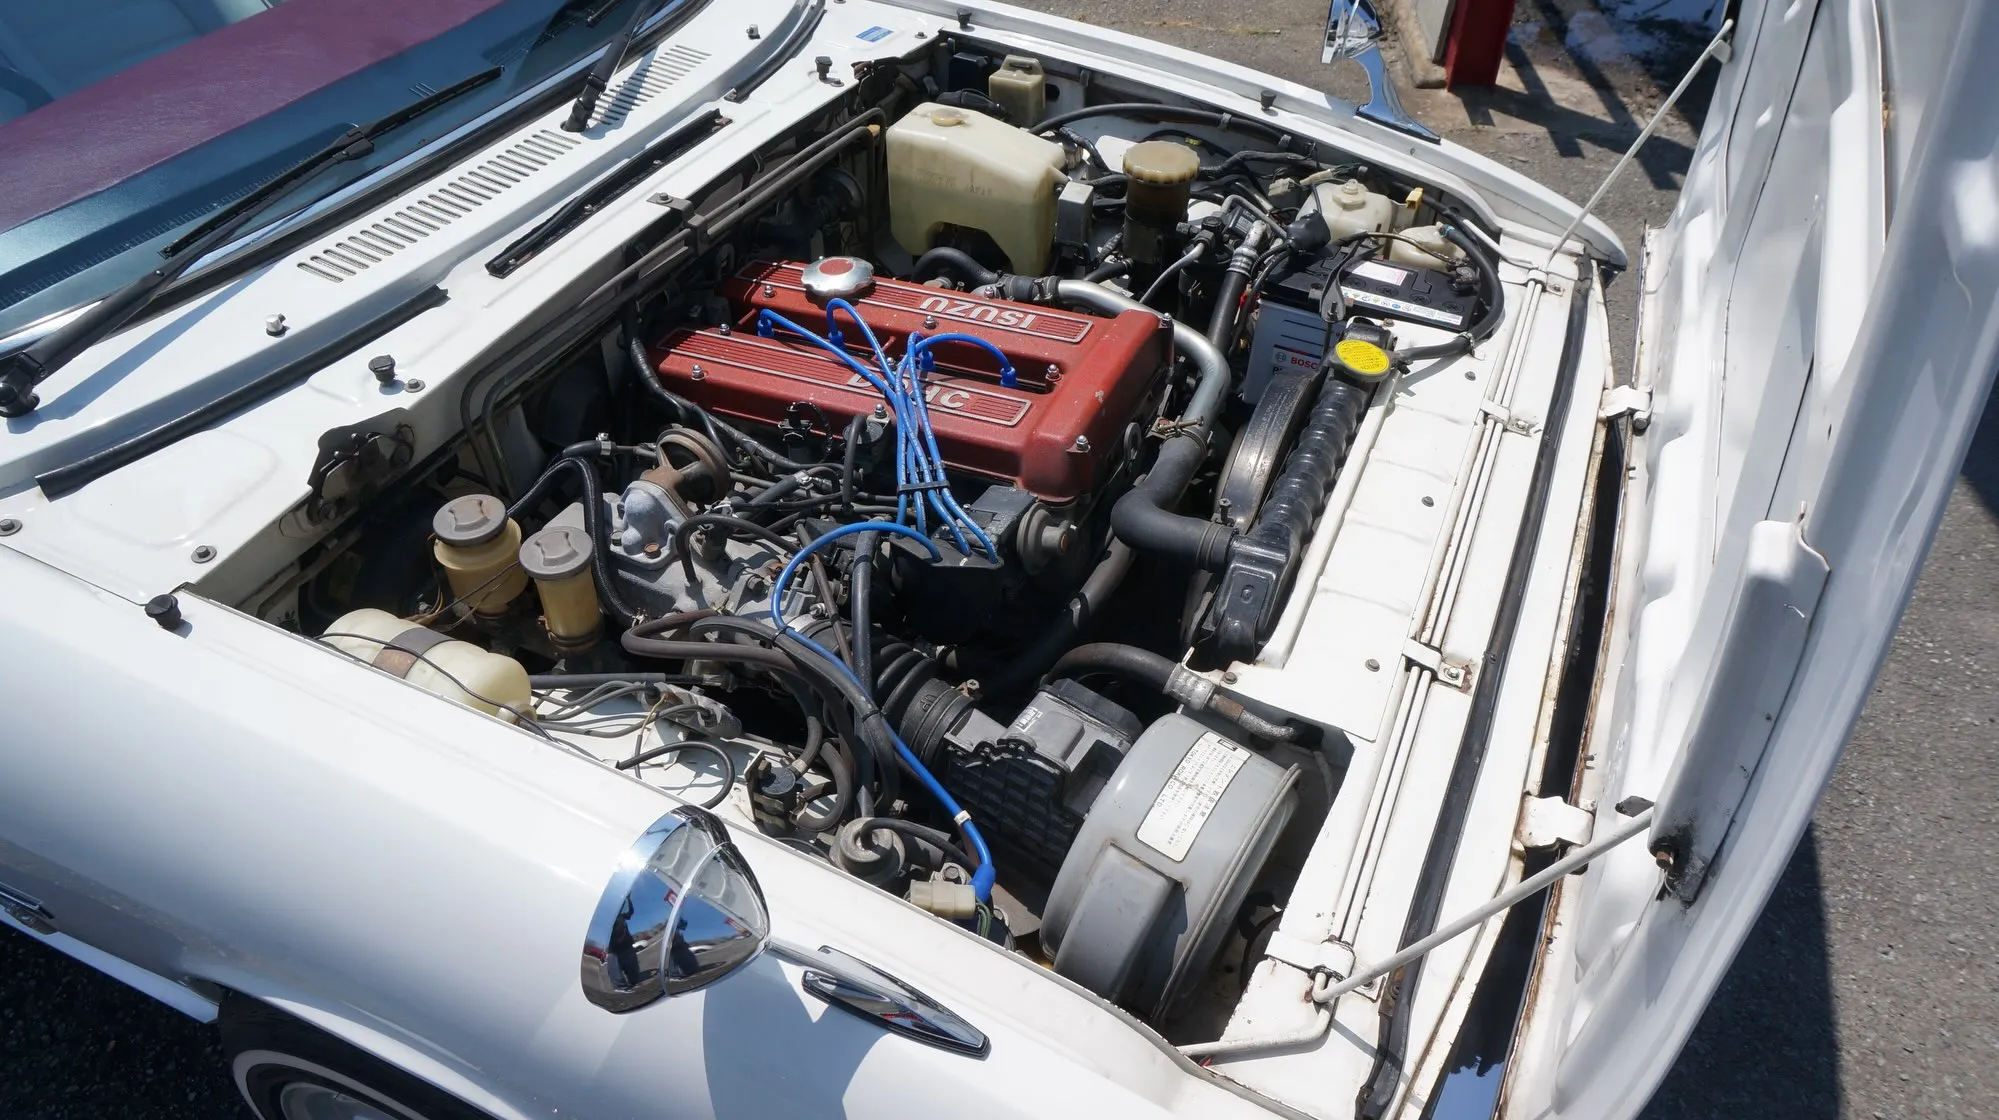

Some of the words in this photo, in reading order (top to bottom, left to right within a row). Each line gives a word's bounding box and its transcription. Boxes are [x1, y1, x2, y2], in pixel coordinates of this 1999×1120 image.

[919, 296, 1037, 329] ISUZU
[1290, 356, 1318, 370] BOSC
[846, 372, 970, 409] DHC
